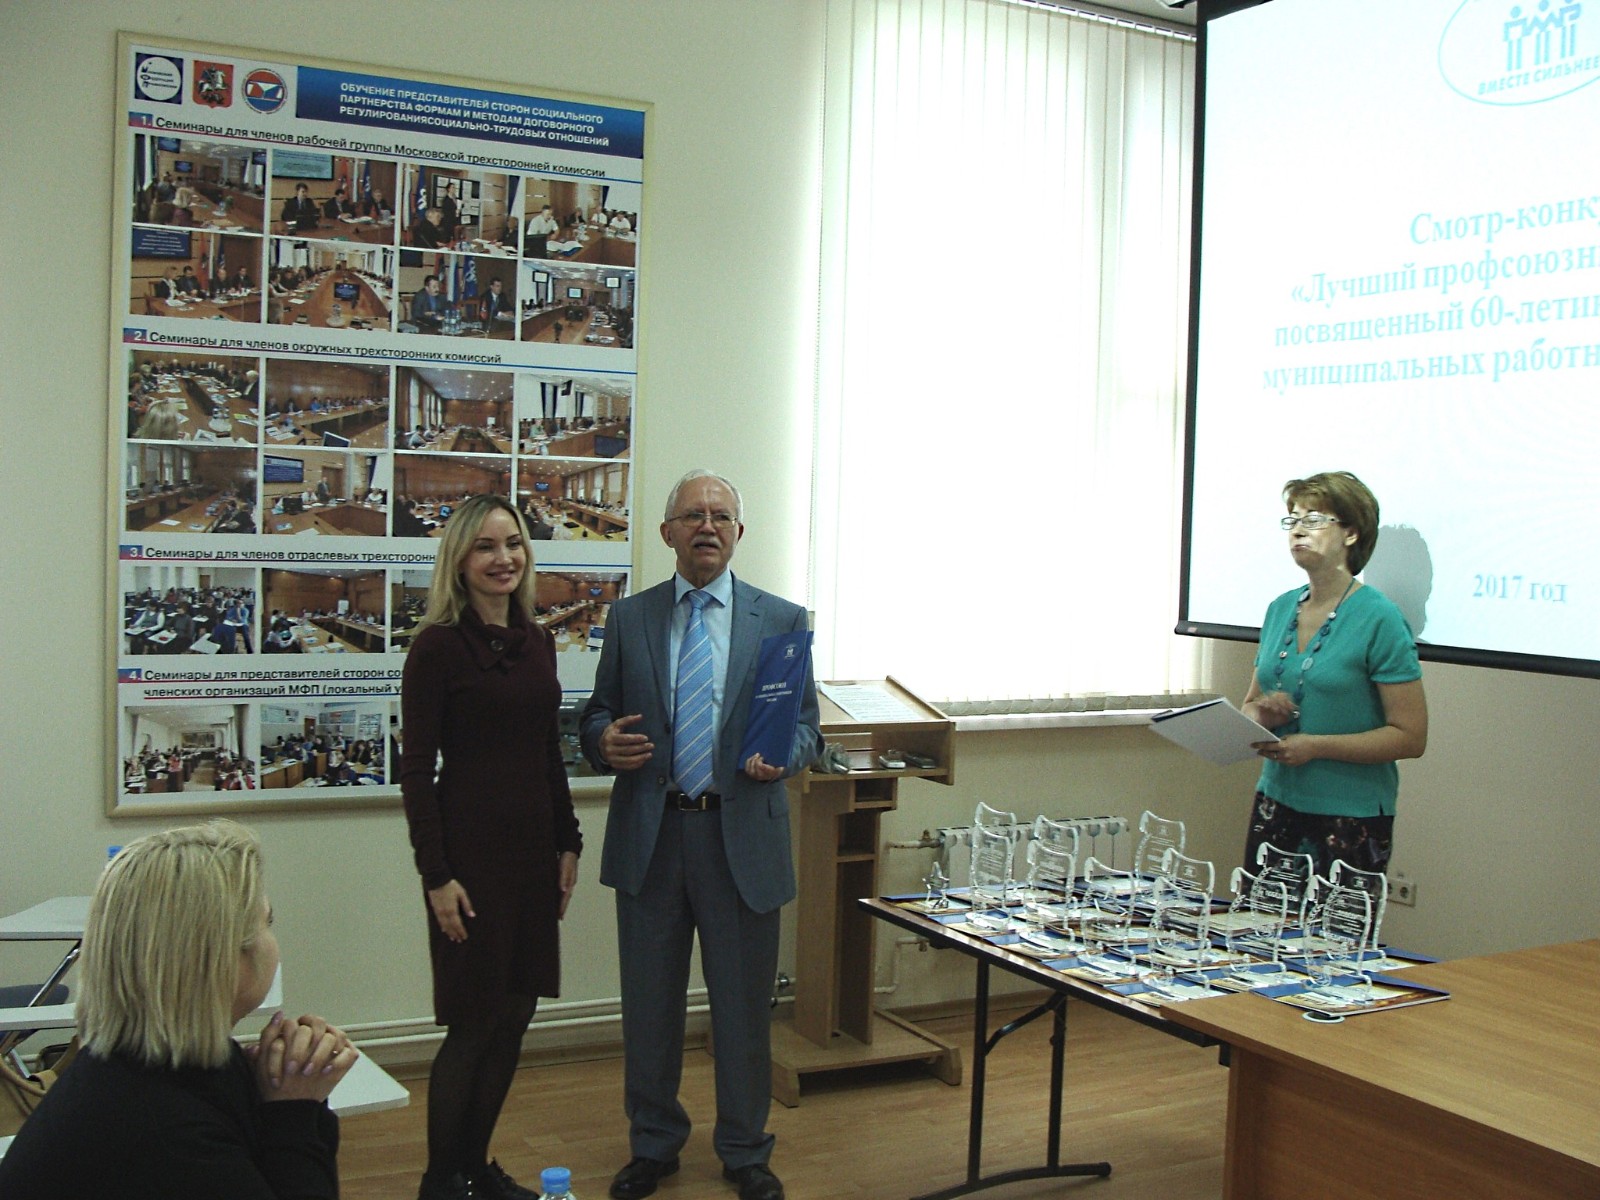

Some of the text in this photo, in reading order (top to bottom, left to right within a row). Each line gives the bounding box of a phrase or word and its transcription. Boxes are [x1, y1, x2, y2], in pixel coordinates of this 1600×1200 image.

[1478, 72, 1531, 96] ВМЕСТЕ
[340, 82, 604, 124] ОБУЧЕНИЕ ПРЕДСТАВИТЕЛЕЙ СТОРОН СОЦИАЛЬНОГО
[340, 94, 595, 134] ПАРТНЕРСТВА ФОРМАМ И МЕТОДАМ ДОГОВОРНОГО
[156, 117, 223, 136] Семинары
[225, 125, 249, 138] для
[251, 129, 294, 142] членов
[296, 134, 348, 149] рабочей
[349, 140, 392, 154] группы
[394, 144, 465, 161] Московской
[467, 153, 550, 171] трехсторонней
[552, 164, 606, 178] комиссии
[548, 131, 610, 147] ОТНОШЕНИЙ
[1291, 246, 1600, 309] «Лучший профсоюзн
[1275, 301, 1464, 347] посвященный
[149, 331, 218, 346] Семинары
[219, 337, 243, 348] для
[245, 340, 289, 350] членов
[292, 343, 352, 356] окружных
[355, 346, 443, 361] трехсторонних
[445, 350, 502, 364] комиссий
[1263, 352, 1485, 396] муниципальных
[145, 547, 213, 560] Семинары
[215, 550, 239, 560] для
[241, 550, 285, 560] членов
[287, 551, 359, 562] отраслевых
[1472, 574, 1569, 604] 2017 год
[143, 687, 203, 697] членских
[205, 685, 286, 697] организаций
[288, 684, 320, 695] МФП
[322, 683, 392, 696] (локальный
[144, 670, 212, 681] Семинары
[214, 671, 238, 680] для
[240, 668, 341, 681] представителей
[342, 669, 385, 679] сторон
